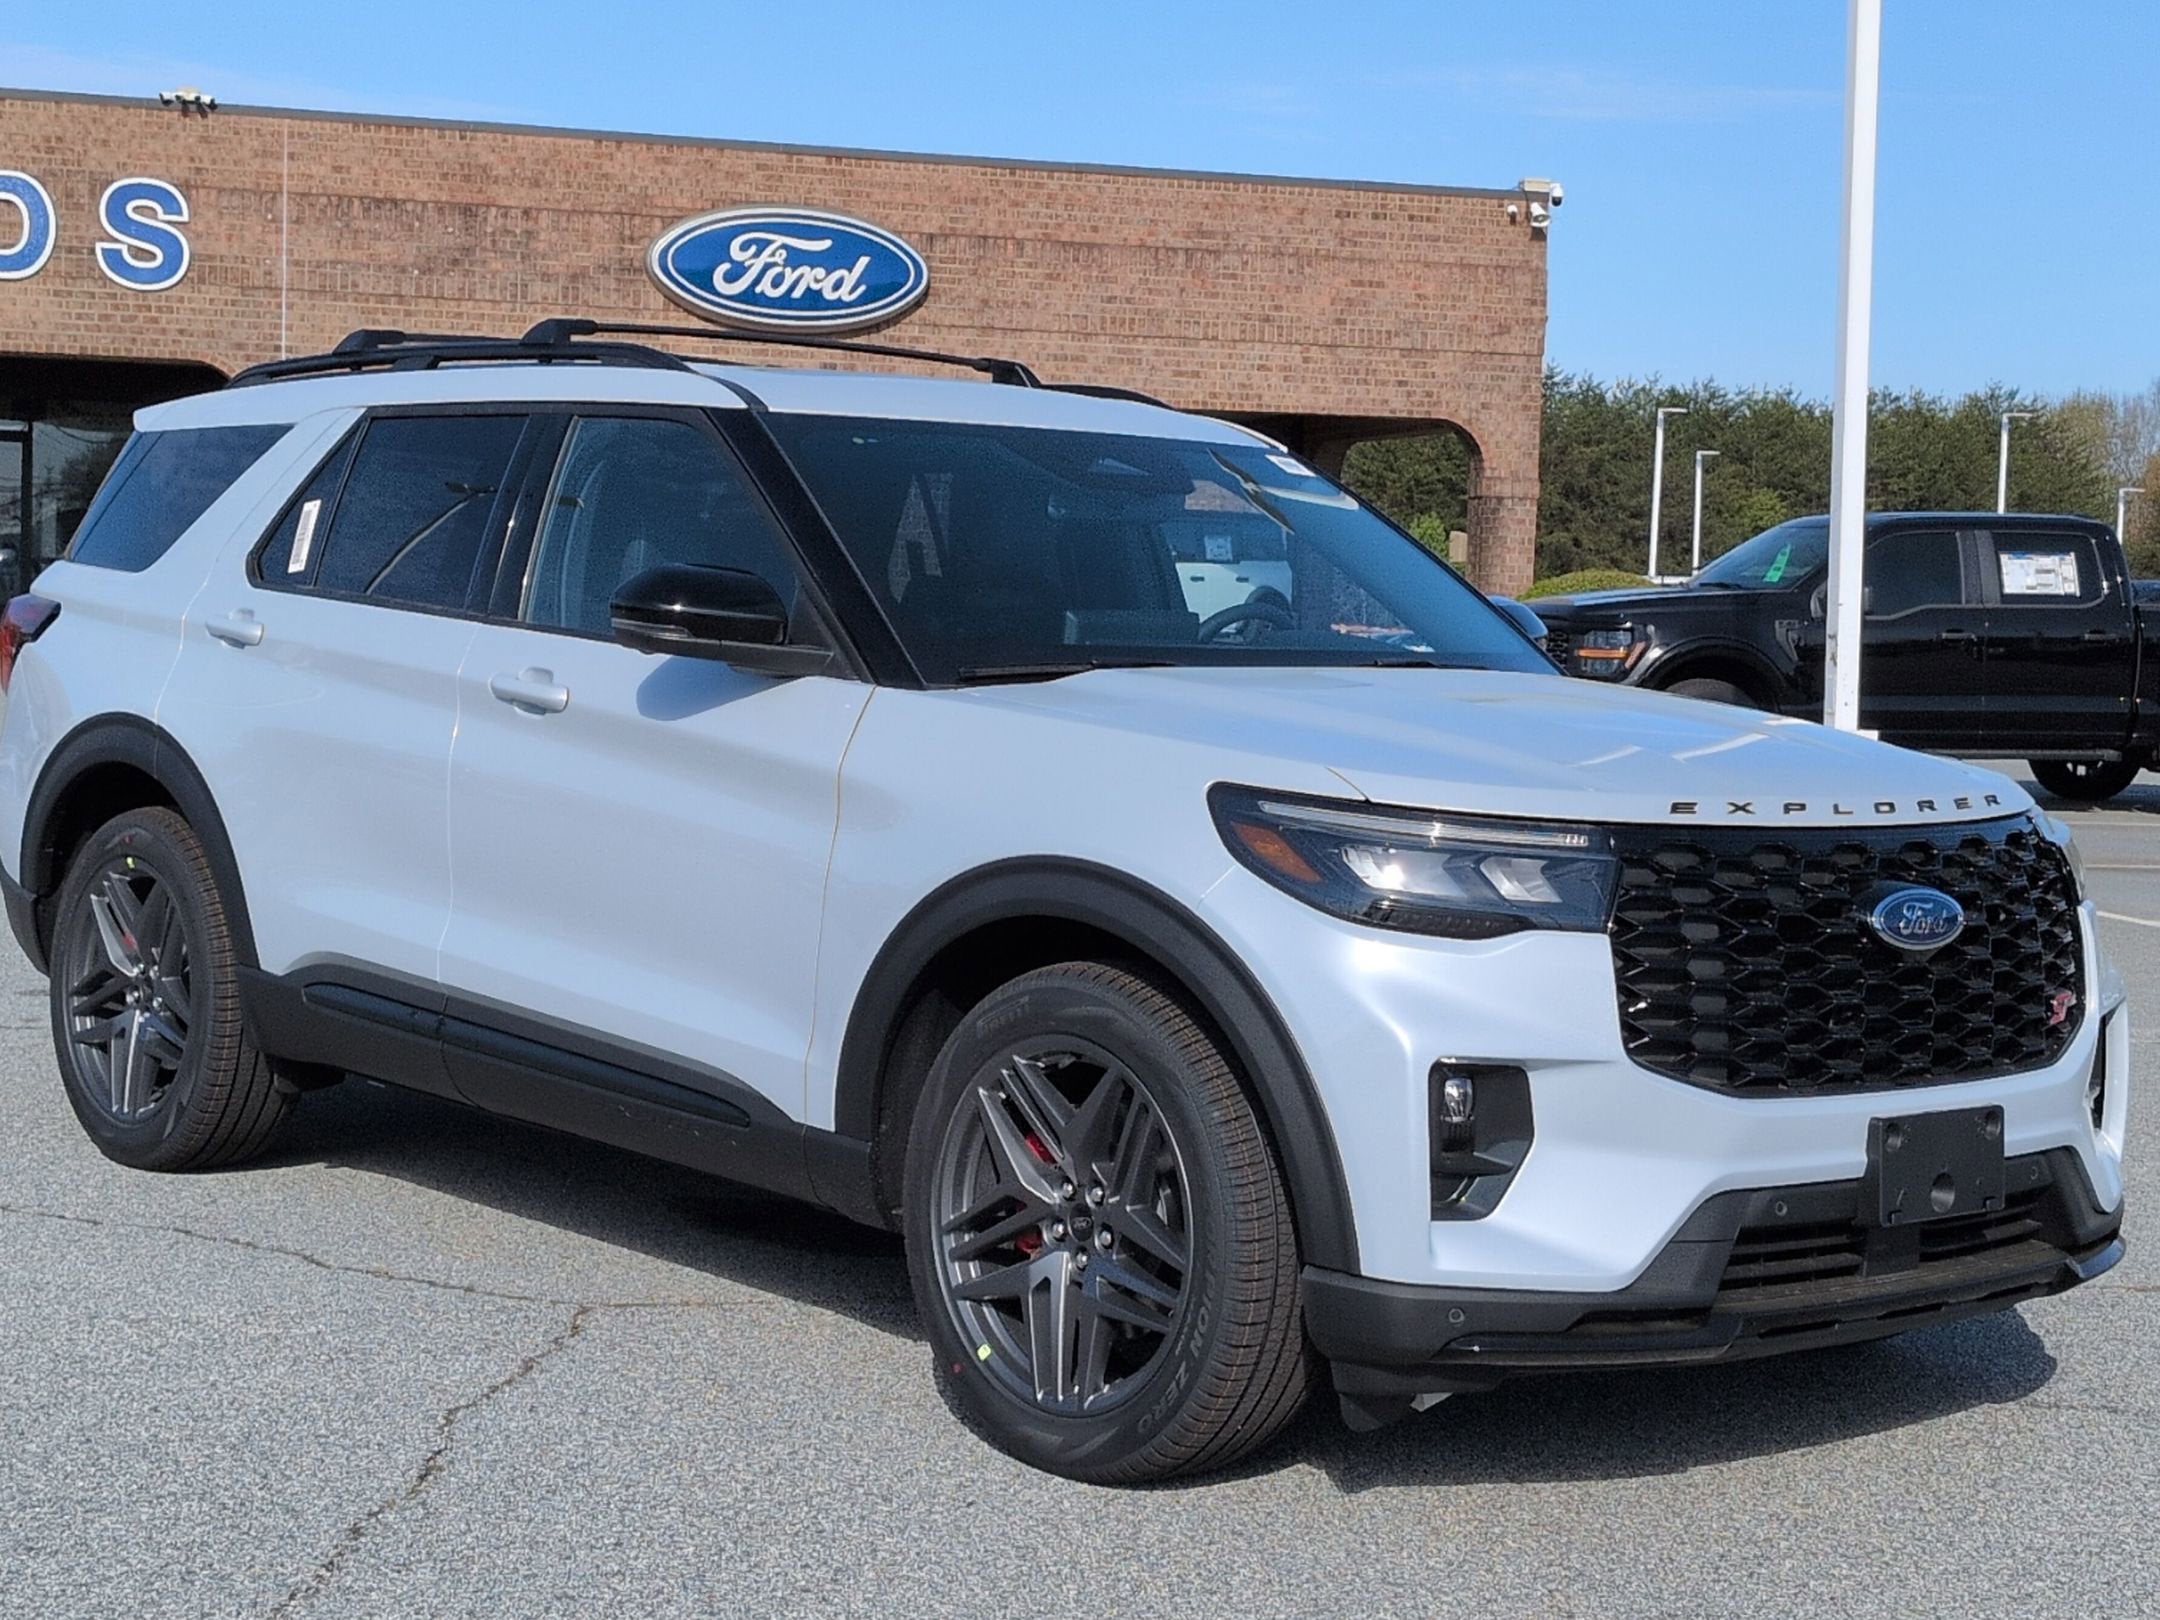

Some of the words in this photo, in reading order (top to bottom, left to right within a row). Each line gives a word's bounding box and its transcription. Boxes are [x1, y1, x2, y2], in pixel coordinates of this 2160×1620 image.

[712, 231, 871, 302] Ford
[1669, 794, 2001, 816] EXPLORER
[1899, 902, 1947, 935] Ford
